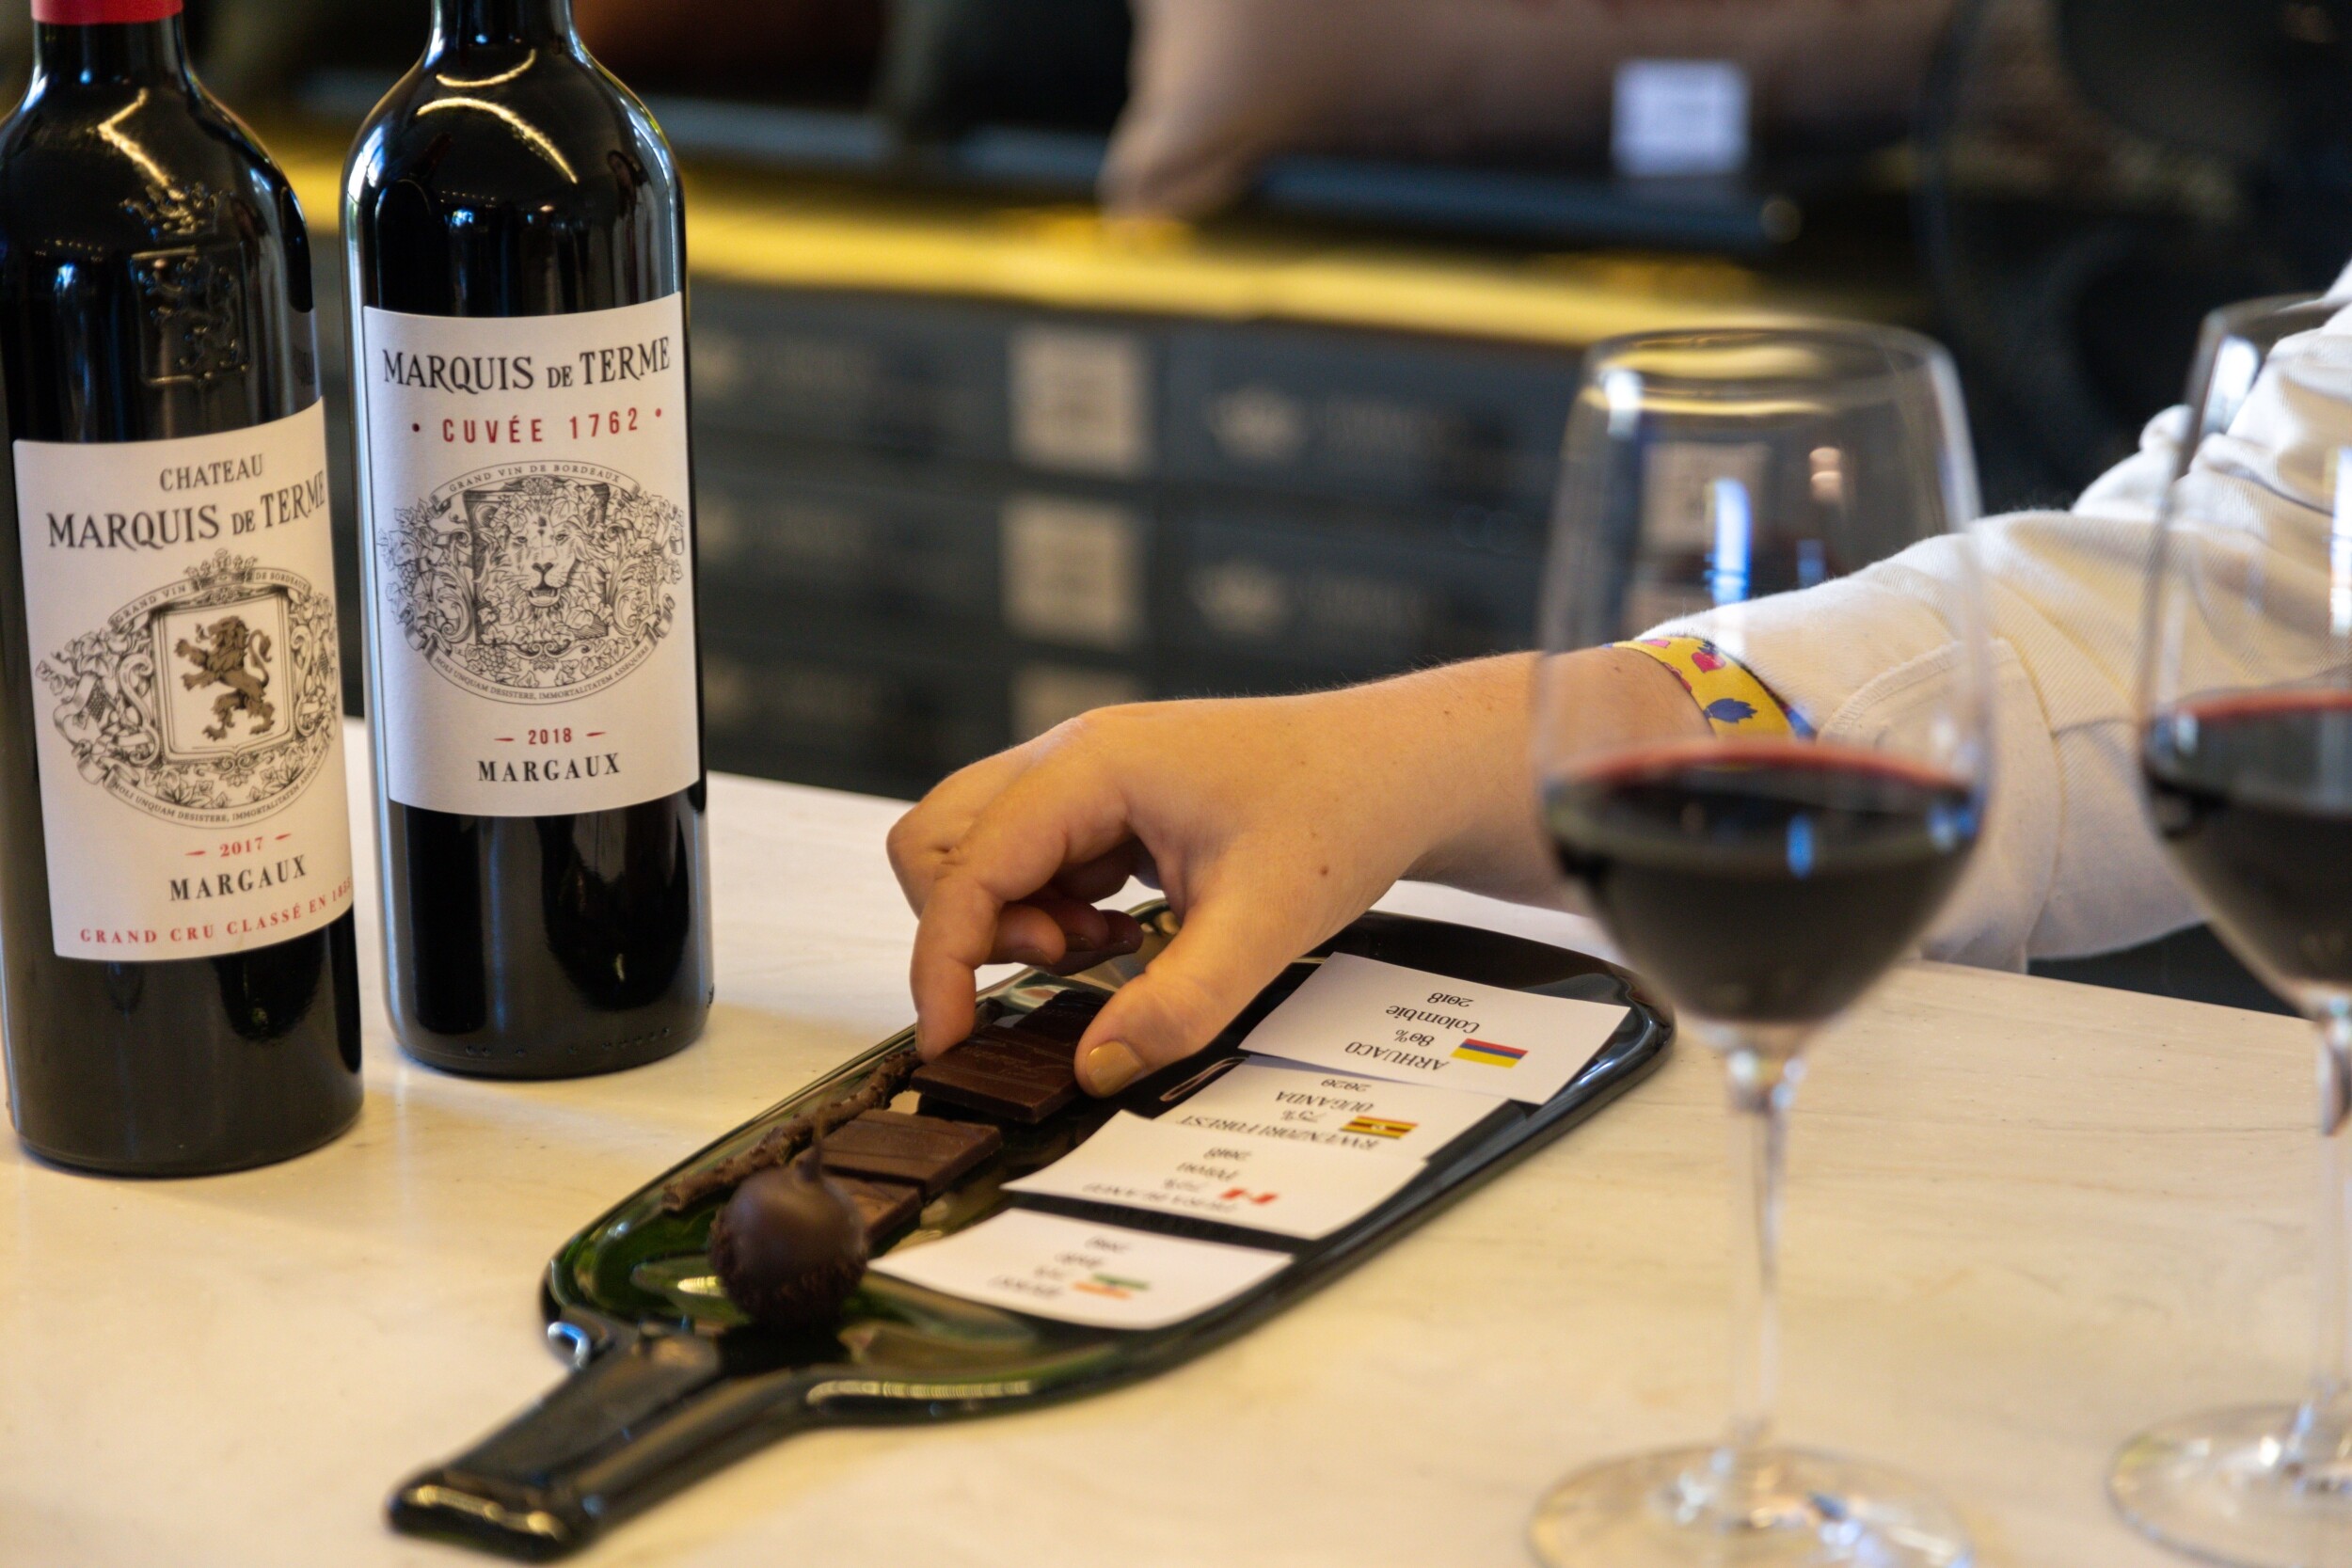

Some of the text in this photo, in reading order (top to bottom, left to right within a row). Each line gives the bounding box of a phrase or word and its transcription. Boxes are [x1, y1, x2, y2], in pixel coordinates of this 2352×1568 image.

[382, 336, 670, 395] MARQUIS DE TERME
[442, 407, 638, 443] CUVÉE 1762
[160, 453, 263, 491] CHATEAU
[449, 472, 491, 492] GRAND
[498, 466, 522, 477] VIN
[553, 464, 620, 483] BORDEAUX
[46, 469, 326, 551] MARQUIS DE TERME
[115, 570, 307, 624] GRAND VIN DE BORDEAUX
[435, 656, 453, 673] NOLI
[453, 671, 489, 692] UNQUAM
[539, 674, 612, 699] IMMORTALITATEM
[528, 727, 573, 745] 2018
[478, 752, 621, 783] MARGAUX
[135, 796, 175, 817] UNQUAM
[220, 836, 263, 858] 2017
[169, 854, 307, 901] MARGAUX
[80, 876, 351, 943] GRAND CRU CLASSÉ EN 1855
[1427, 992, 1474, 1007] 2018
[1386, 1005, 1480, 1034] Colombie
[1394, 1029, 1435, 1047] 80%
[1344, 1040, 1450, 1070] ARHUACO
[1321, 1079, 1372, 1092] 2020
[1276, 1091, 1375, 1113] OUGANDA
